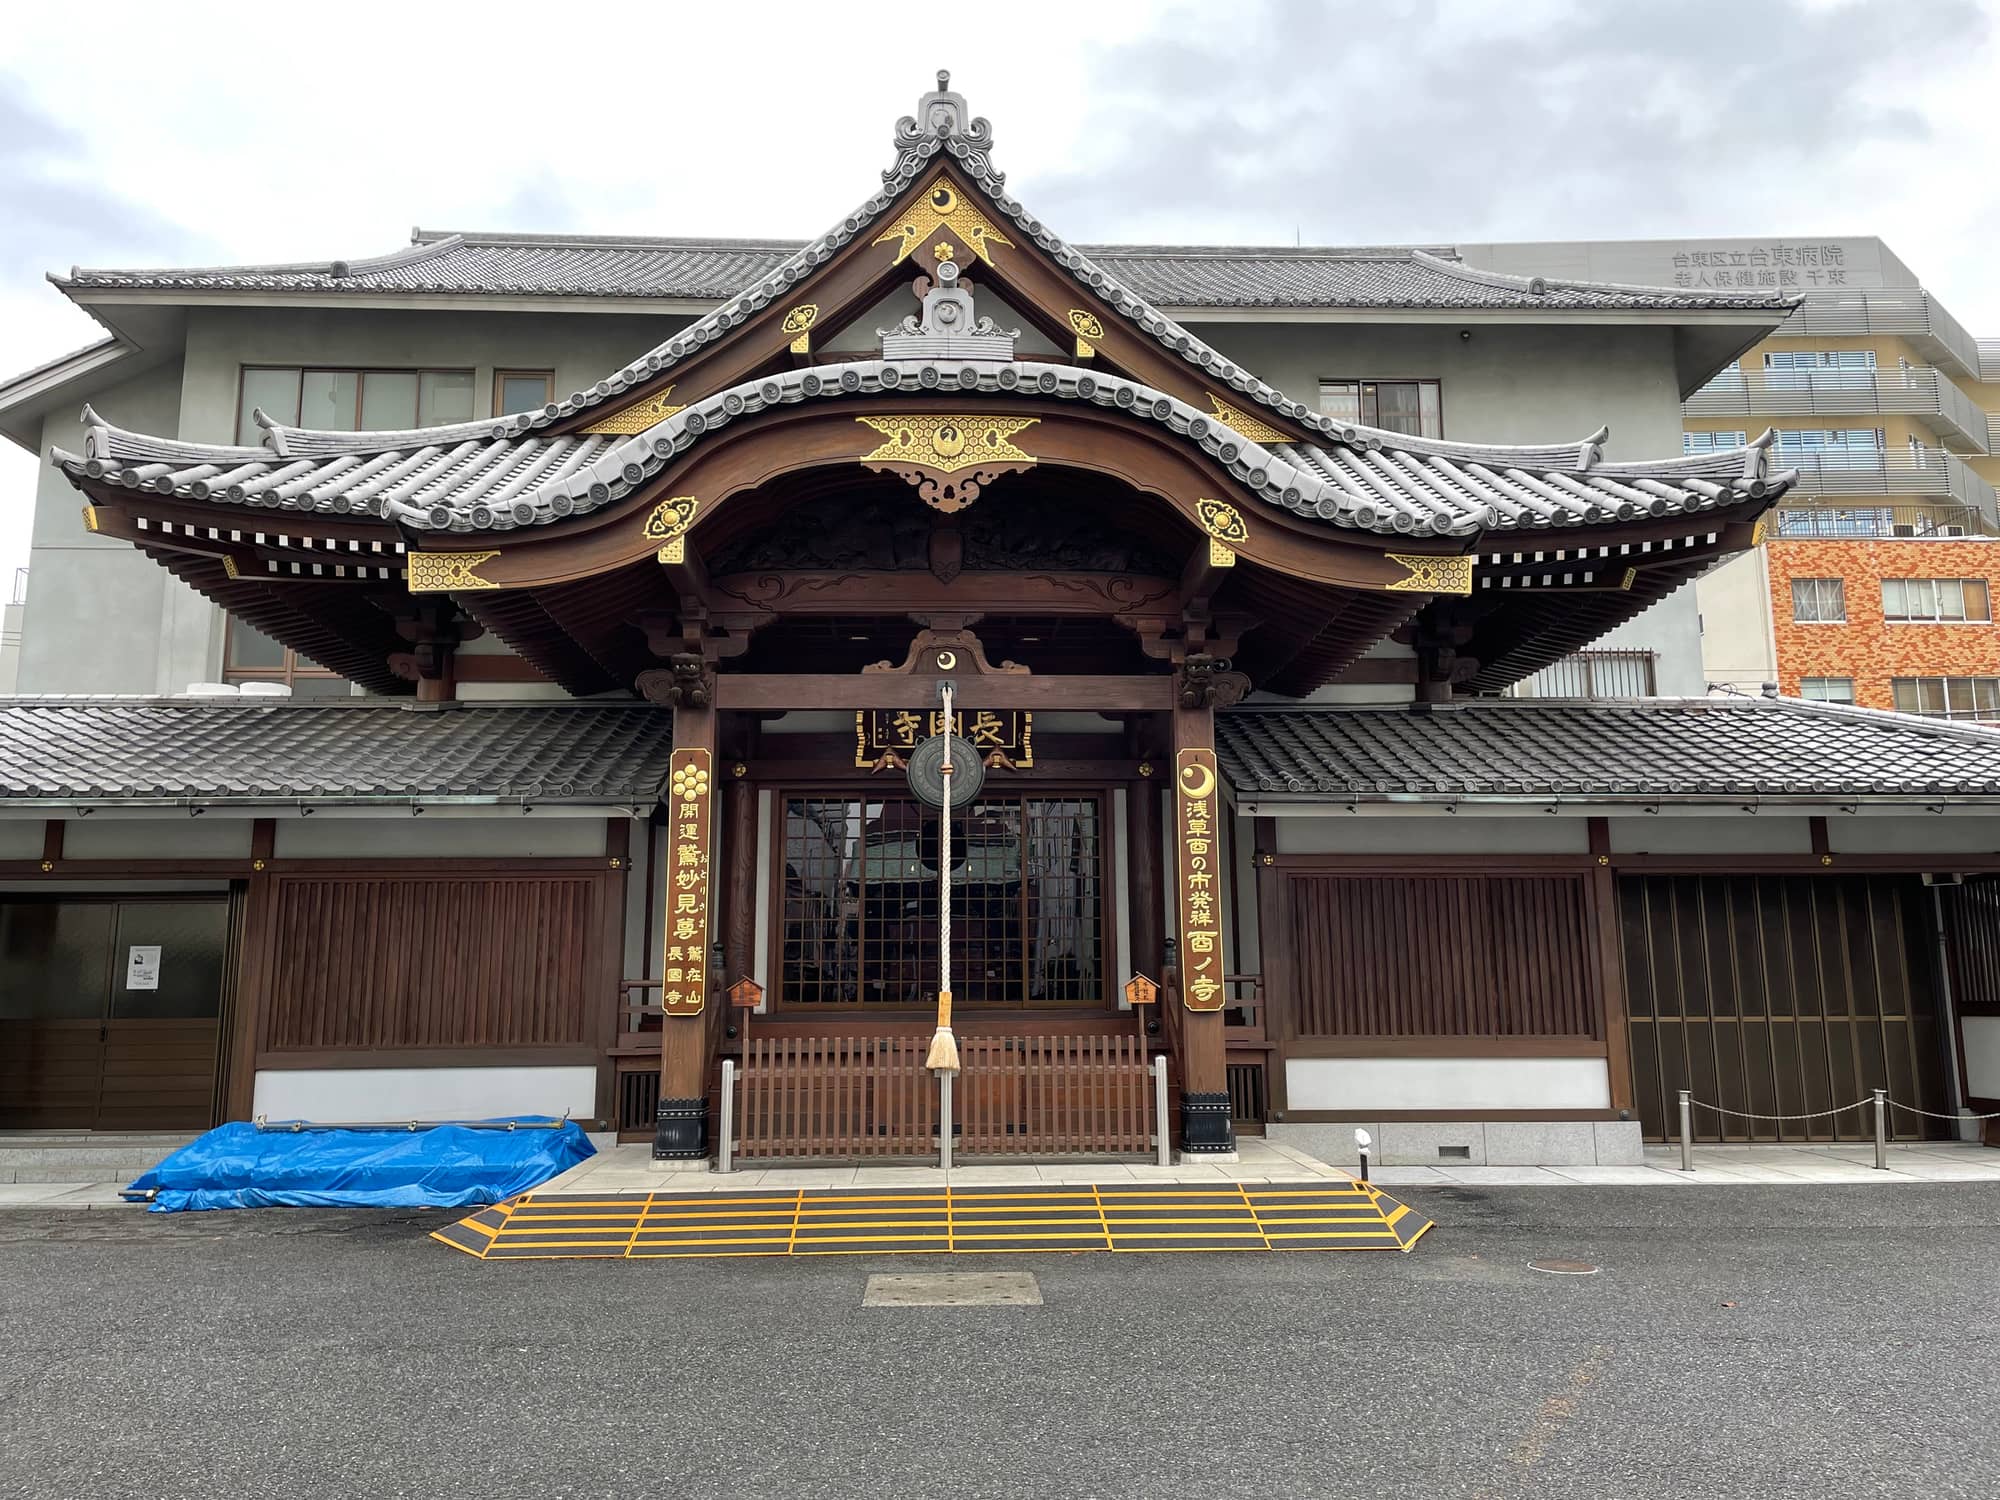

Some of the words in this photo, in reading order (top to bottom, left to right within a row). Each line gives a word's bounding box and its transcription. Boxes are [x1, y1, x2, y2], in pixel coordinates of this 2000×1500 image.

[1672, 244, 1844, 268] 台東区立台東病院
[1674, 270, 1798, 288] 老人保健施設
[673, 803, 702, 940] 開運鷲妙見尊
[699, 853, 709, 928] おとりさま
